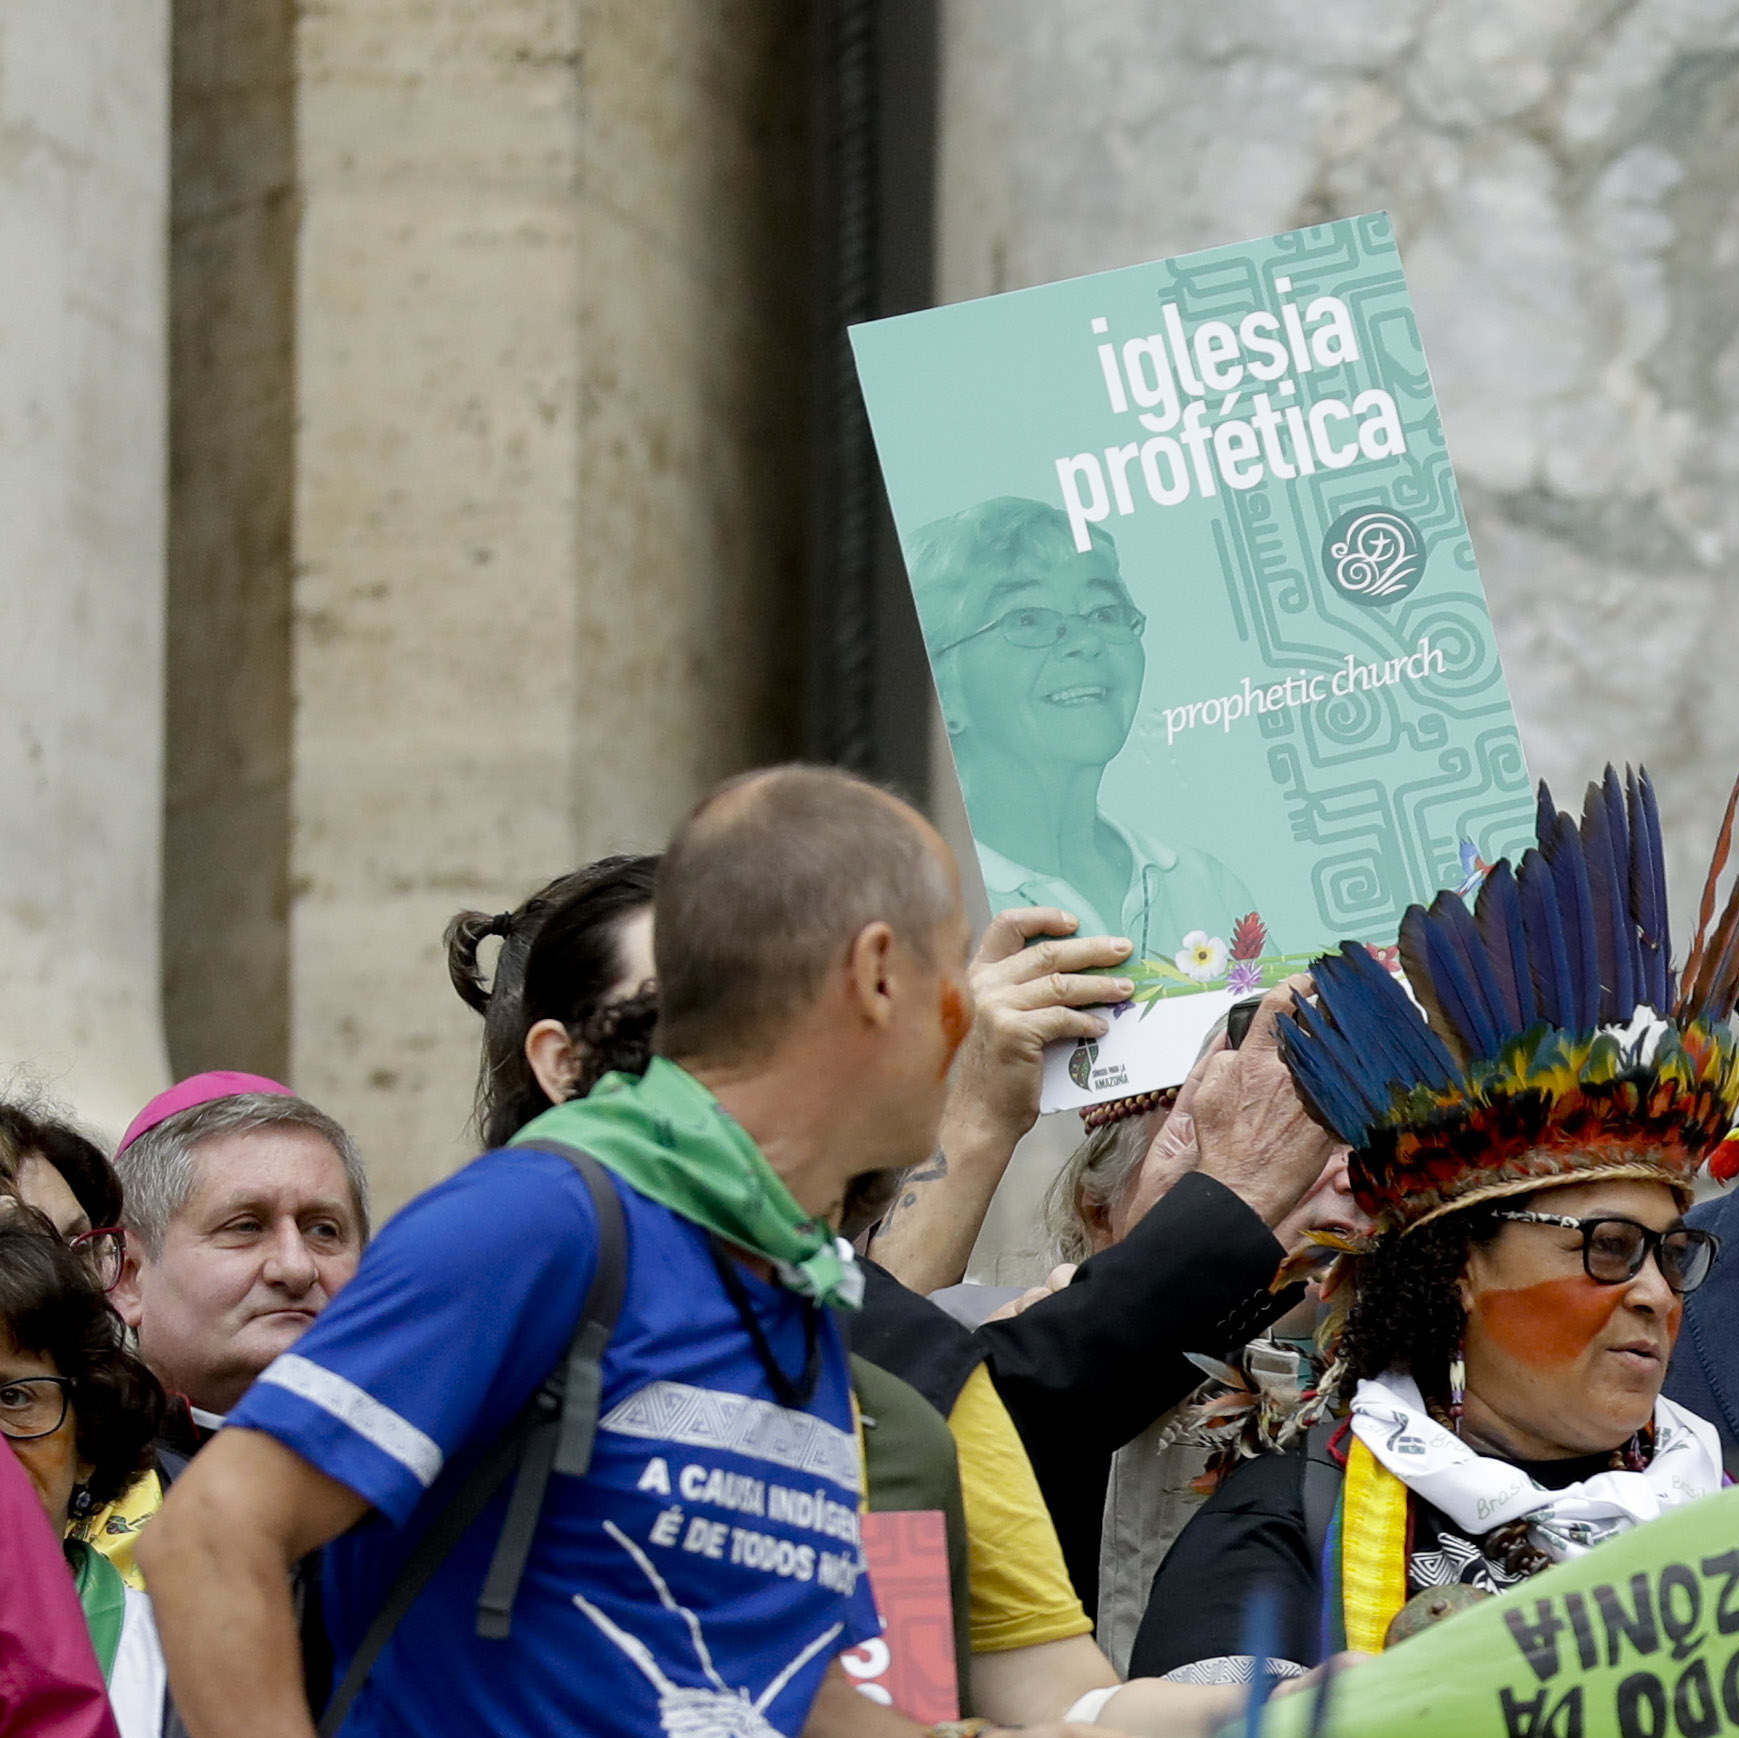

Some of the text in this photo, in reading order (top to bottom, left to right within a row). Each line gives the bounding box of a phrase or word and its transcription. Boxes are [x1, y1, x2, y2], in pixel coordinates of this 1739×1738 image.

[1090, 278, 1361, 433] iglesia
[1055, 380, 1407, 553] profética
[1162, 637, 1447, 745] prophetic church
[637, 1456, 671, 1496] A
[679, 1464, 766, 1517] CAUSA
[649, 1503, 684, 1548] É
[683, 1516, 730, 1560] DE
[731, 1526, 817, 1583] TODOS
